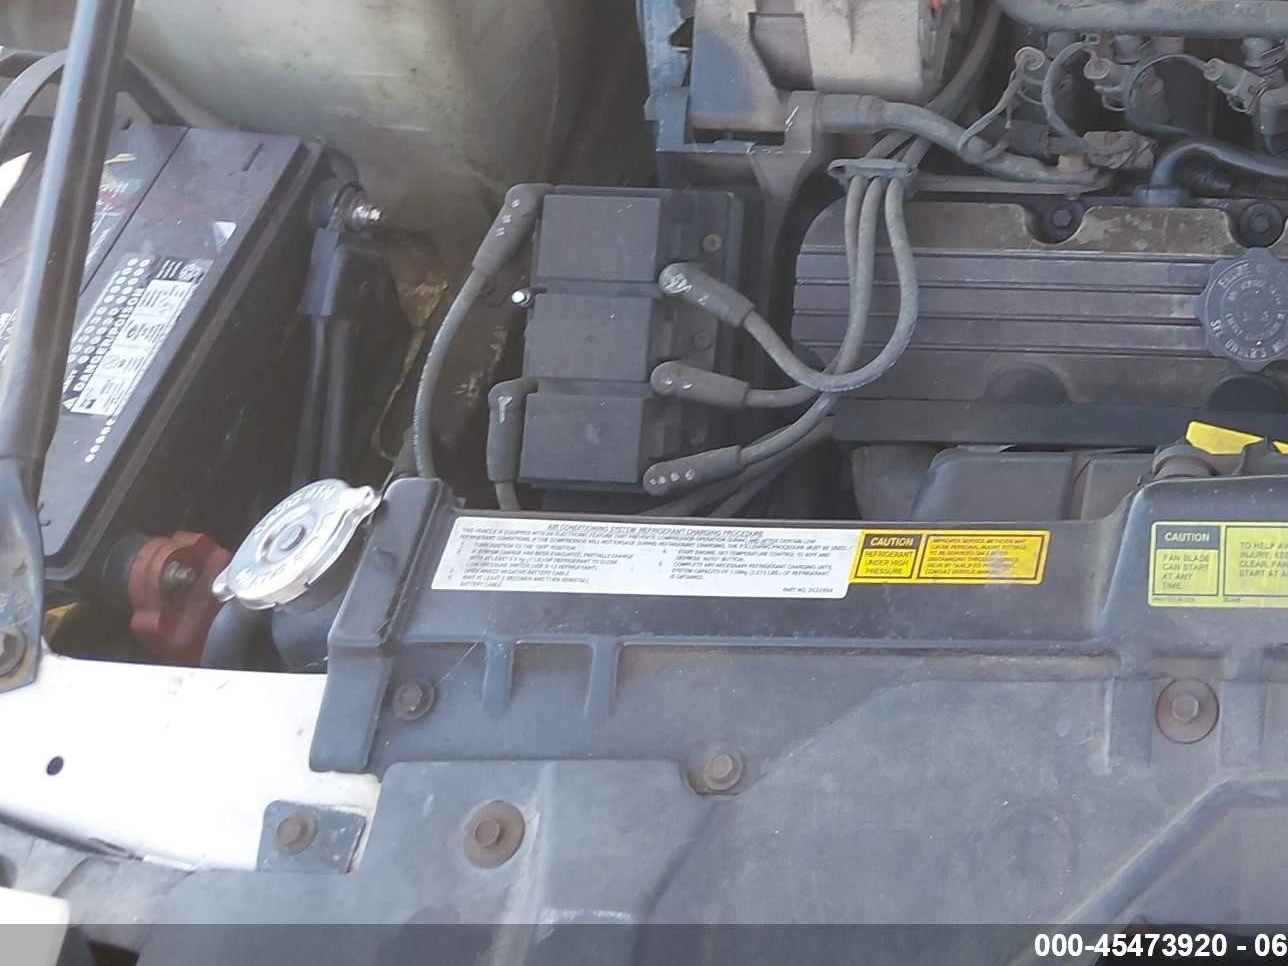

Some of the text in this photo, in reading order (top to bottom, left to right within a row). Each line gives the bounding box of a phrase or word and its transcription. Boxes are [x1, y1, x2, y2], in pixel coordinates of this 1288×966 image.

[72, 286, 146, 393] DANGER/POISON
[560, 524, 608, 533] CONDITIONING
[610, 526, 636, 535] SYSTEM
[637, 526, 686, 536] REFRIGERANT
[686, 529, 722, 537] CHARGING
[870, 537, 914, 547] CAUTION
[1164, 532, 1210, 542] CAUTION
[1183, 554, 1209, 562] BLADE
